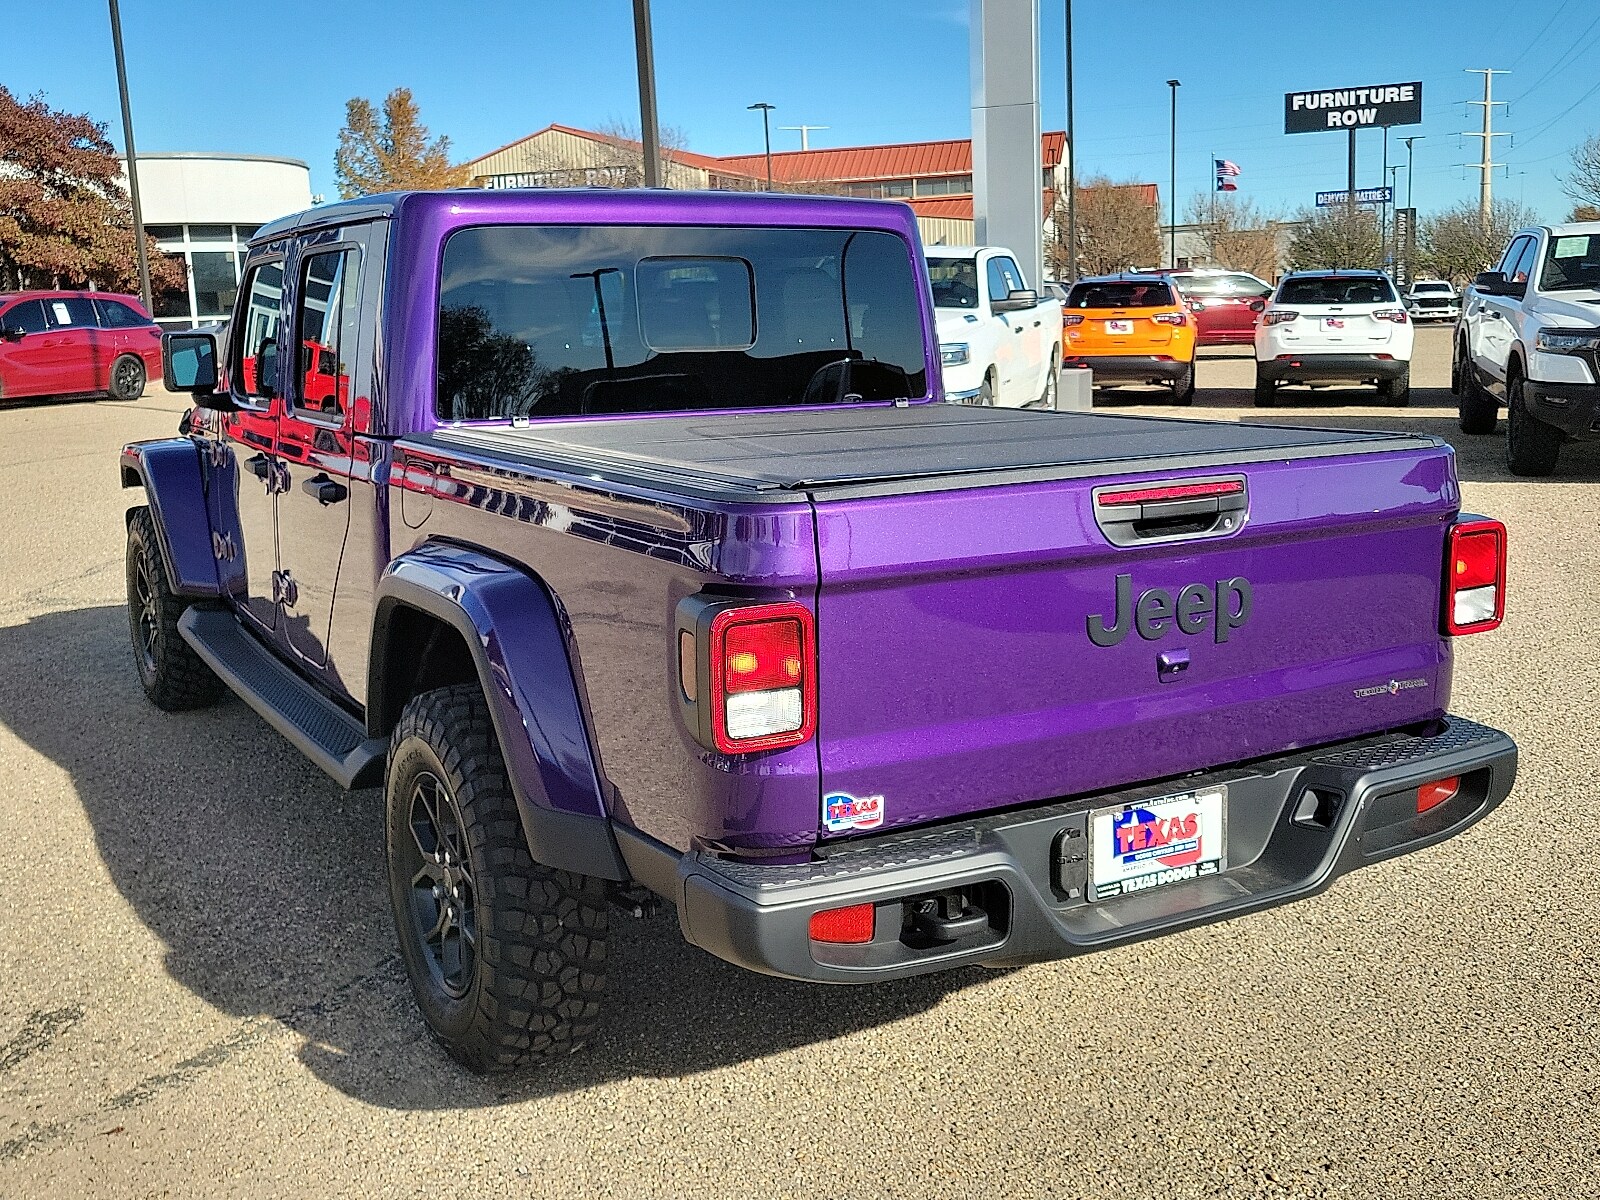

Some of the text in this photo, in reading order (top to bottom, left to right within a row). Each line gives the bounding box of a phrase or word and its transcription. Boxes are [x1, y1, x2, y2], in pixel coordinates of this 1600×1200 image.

[1292, 86, 1415, 111] FURNITURE
[1327, 108, 1378, 127] ROW
[1086, 573, 1252, 647] Jeep
[828, 799, 879, 819] TEXAS
[1116, 813, 1198, 853] TEXAS
[1121, 873, 1158, 894] TEXAS
[1157, 865, 1198, 885] DODGE
